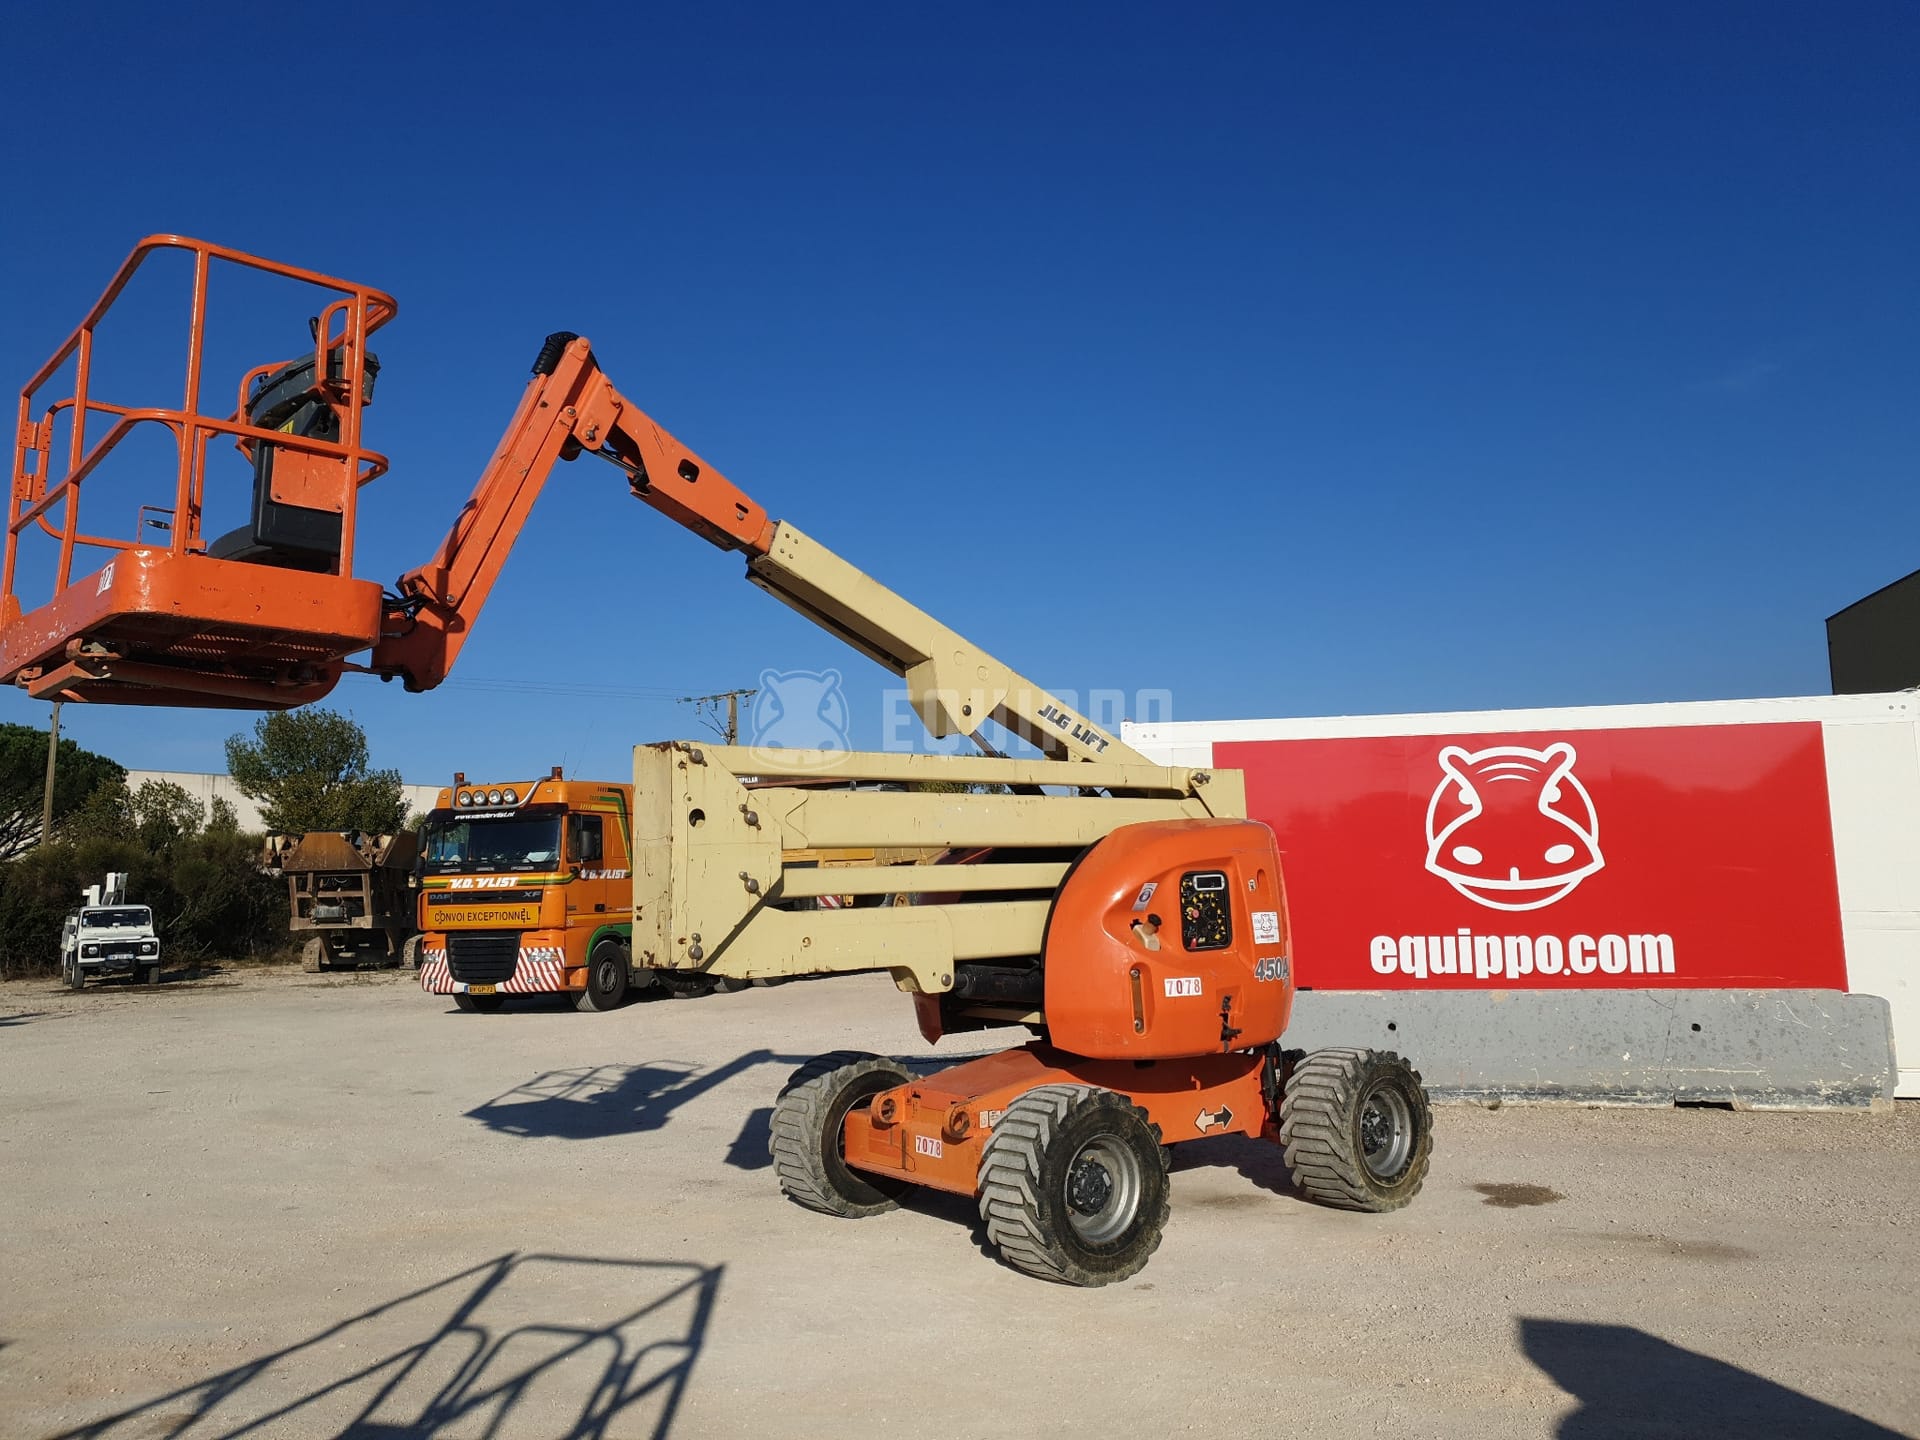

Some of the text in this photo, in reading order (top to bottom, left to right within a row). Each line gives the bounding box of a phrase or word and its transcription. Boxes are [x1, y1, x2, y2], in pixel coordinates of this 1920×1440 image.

[1036, 703, 1110, 753] JLG LIFT
[475, 876, 520, 888] VLIST
[598, 869, 627, 879] VLIST
[434, 909, 531, 923] CONVOI EXCEPTIONNEL
[1369, 927, 1676, 979] equippo.com
[1166, 978, 1201, 995] 7078
[916, 1136, 941, 1156] 7078
